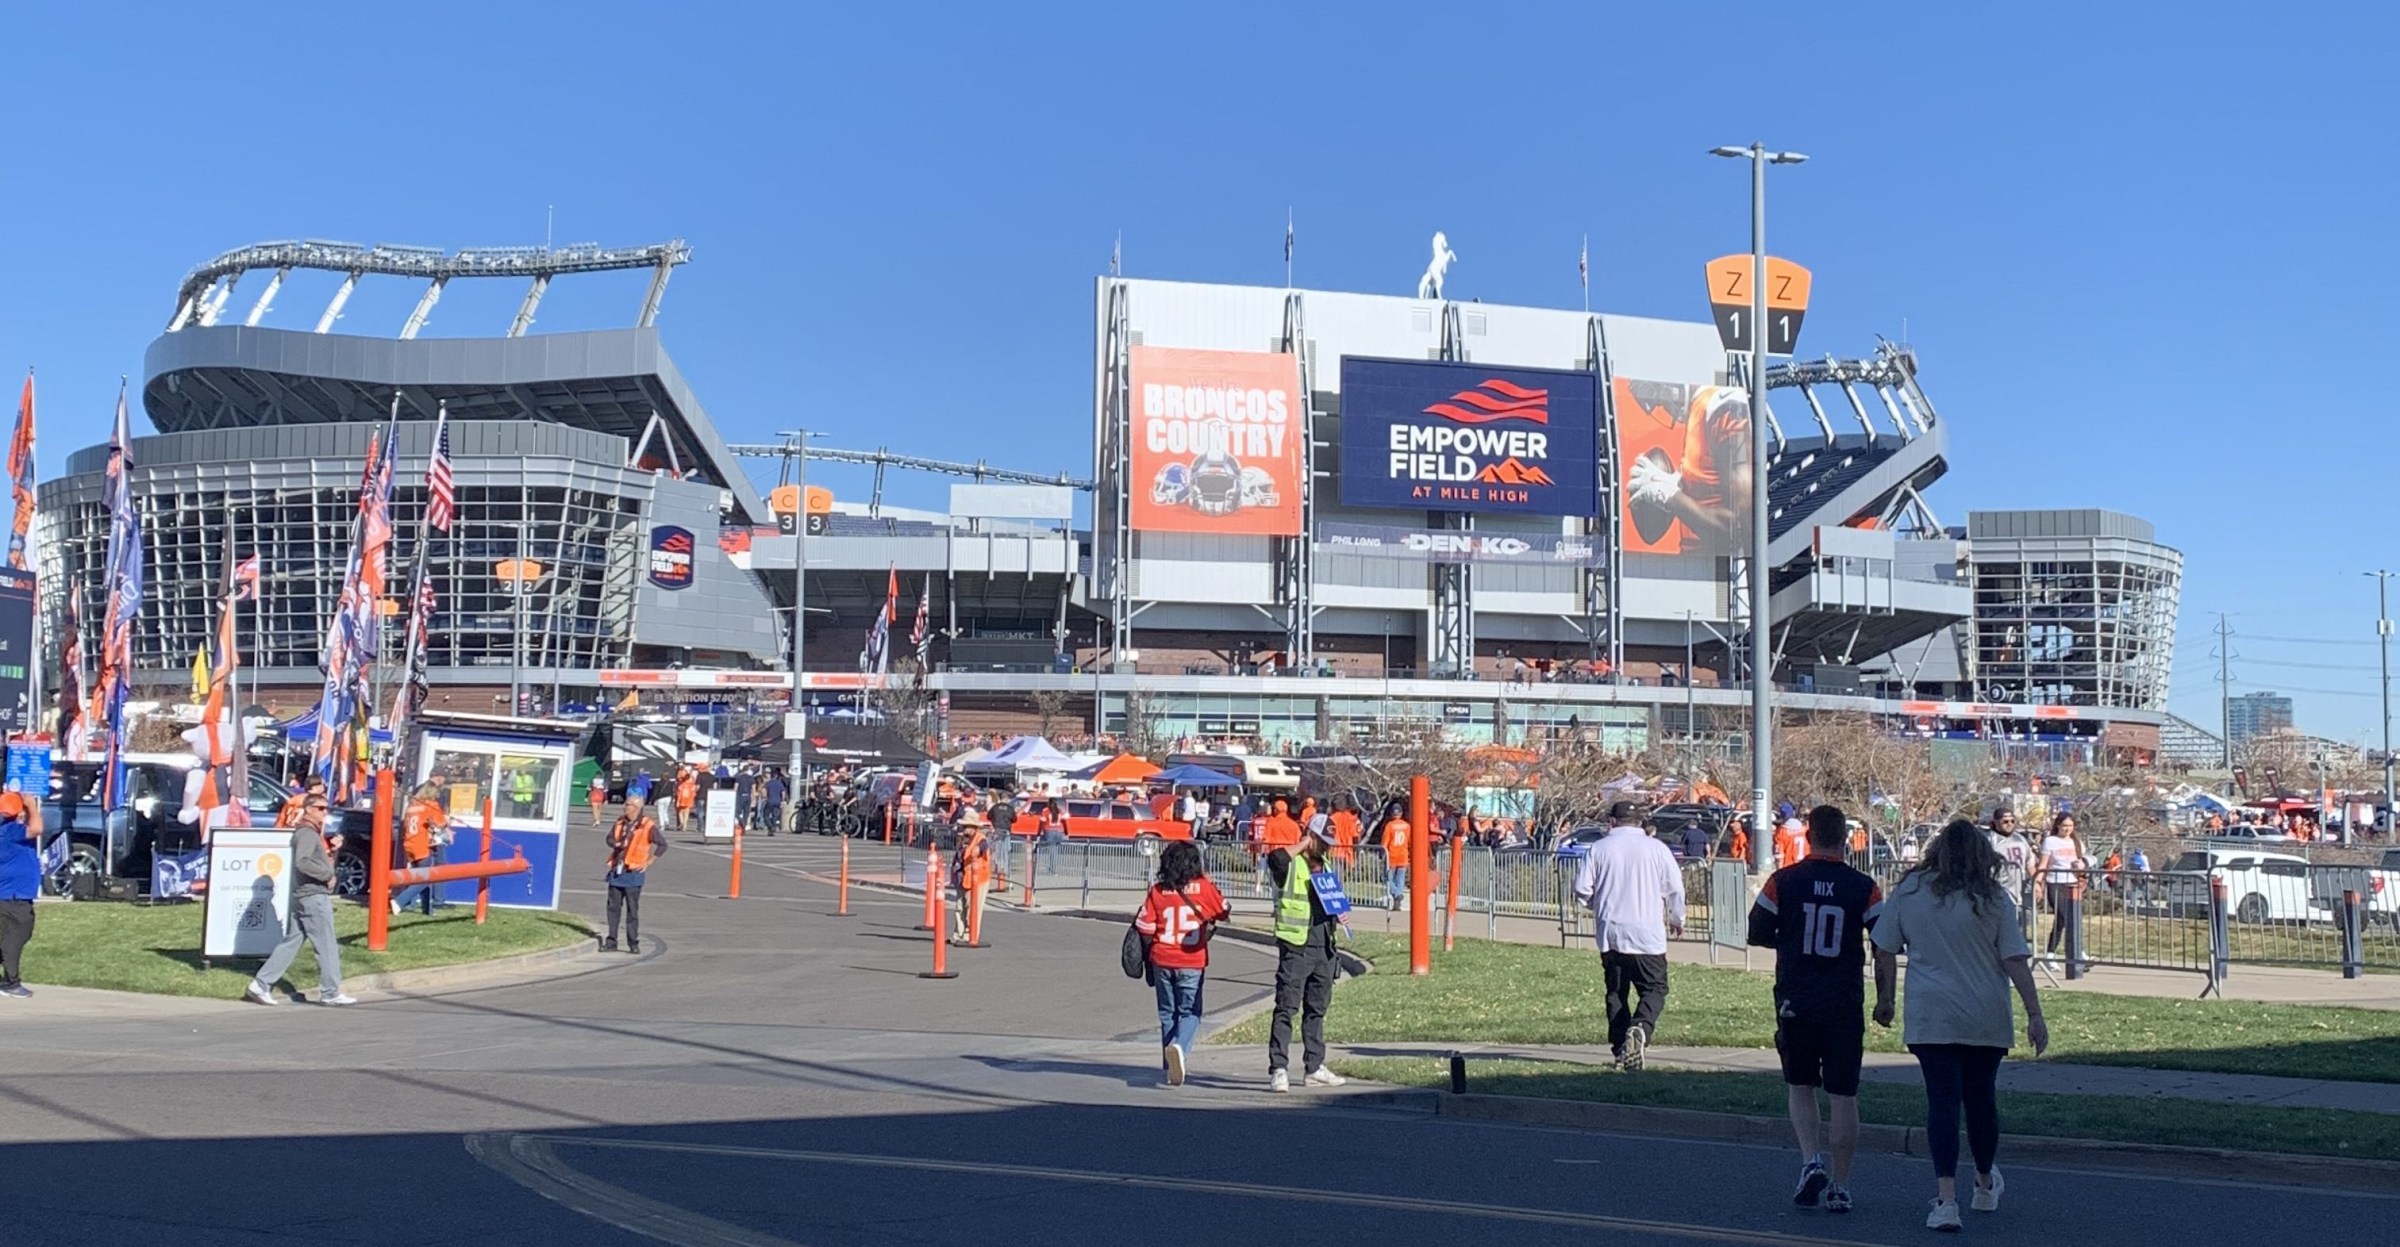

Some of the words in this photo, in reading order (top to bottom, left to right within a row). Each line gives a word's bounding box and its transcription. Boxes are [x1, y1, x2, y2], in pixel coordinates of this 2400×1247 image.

[1726, 271, 1742, 297] Z
[1776, 275, 1792, 301] Z
[1730, 312, 1739, 339] 1
[1779, 315, 1789, 342] 1
[1143, 384, 1288, 423] BRONCOS
[1147, 418, 1286, 458] COUNTRY
[1390, 424, 1547, 458] EMPOWER
[1390, 452, 1477, 482] FIELD
[782, 494, 794, 508] C
[1412, 486, 1432, 498] AT
[1441, 487, 1479, 500] MILE
[1488, 489, 1529, 502] HIGH
[810, 495, 822, 509] C
[782, 514, 793, 529] 3
[810, 516, 821, 531] 3
[1331, 535, 1353, 545] PHIL
[1354, 536, 1381, 547] LONG
[1409, 534, 1471, 552] DEN
[1481, 536, 1522, 555] KC
[652, 550, 690, 565] EMPOWER
[651, 561, 673, 573] FIELD
[504, 581, 512, 591] 2
[524, 581, 532, 592] 2
[1008, 631, 1034, 640] MKT
[654, 693, 708, 703] ELATION
[1991, 688, 1999, 698] 9
[1394, 831, 1405, 847] 10
[222, 859, 251, 871] LOT
[264, 859, 277, 872] C
[1814, 881, 1834, 896] NIX
[1158, 905, 1200, 945] 15
[1803, 902, 1845, 957] 10
